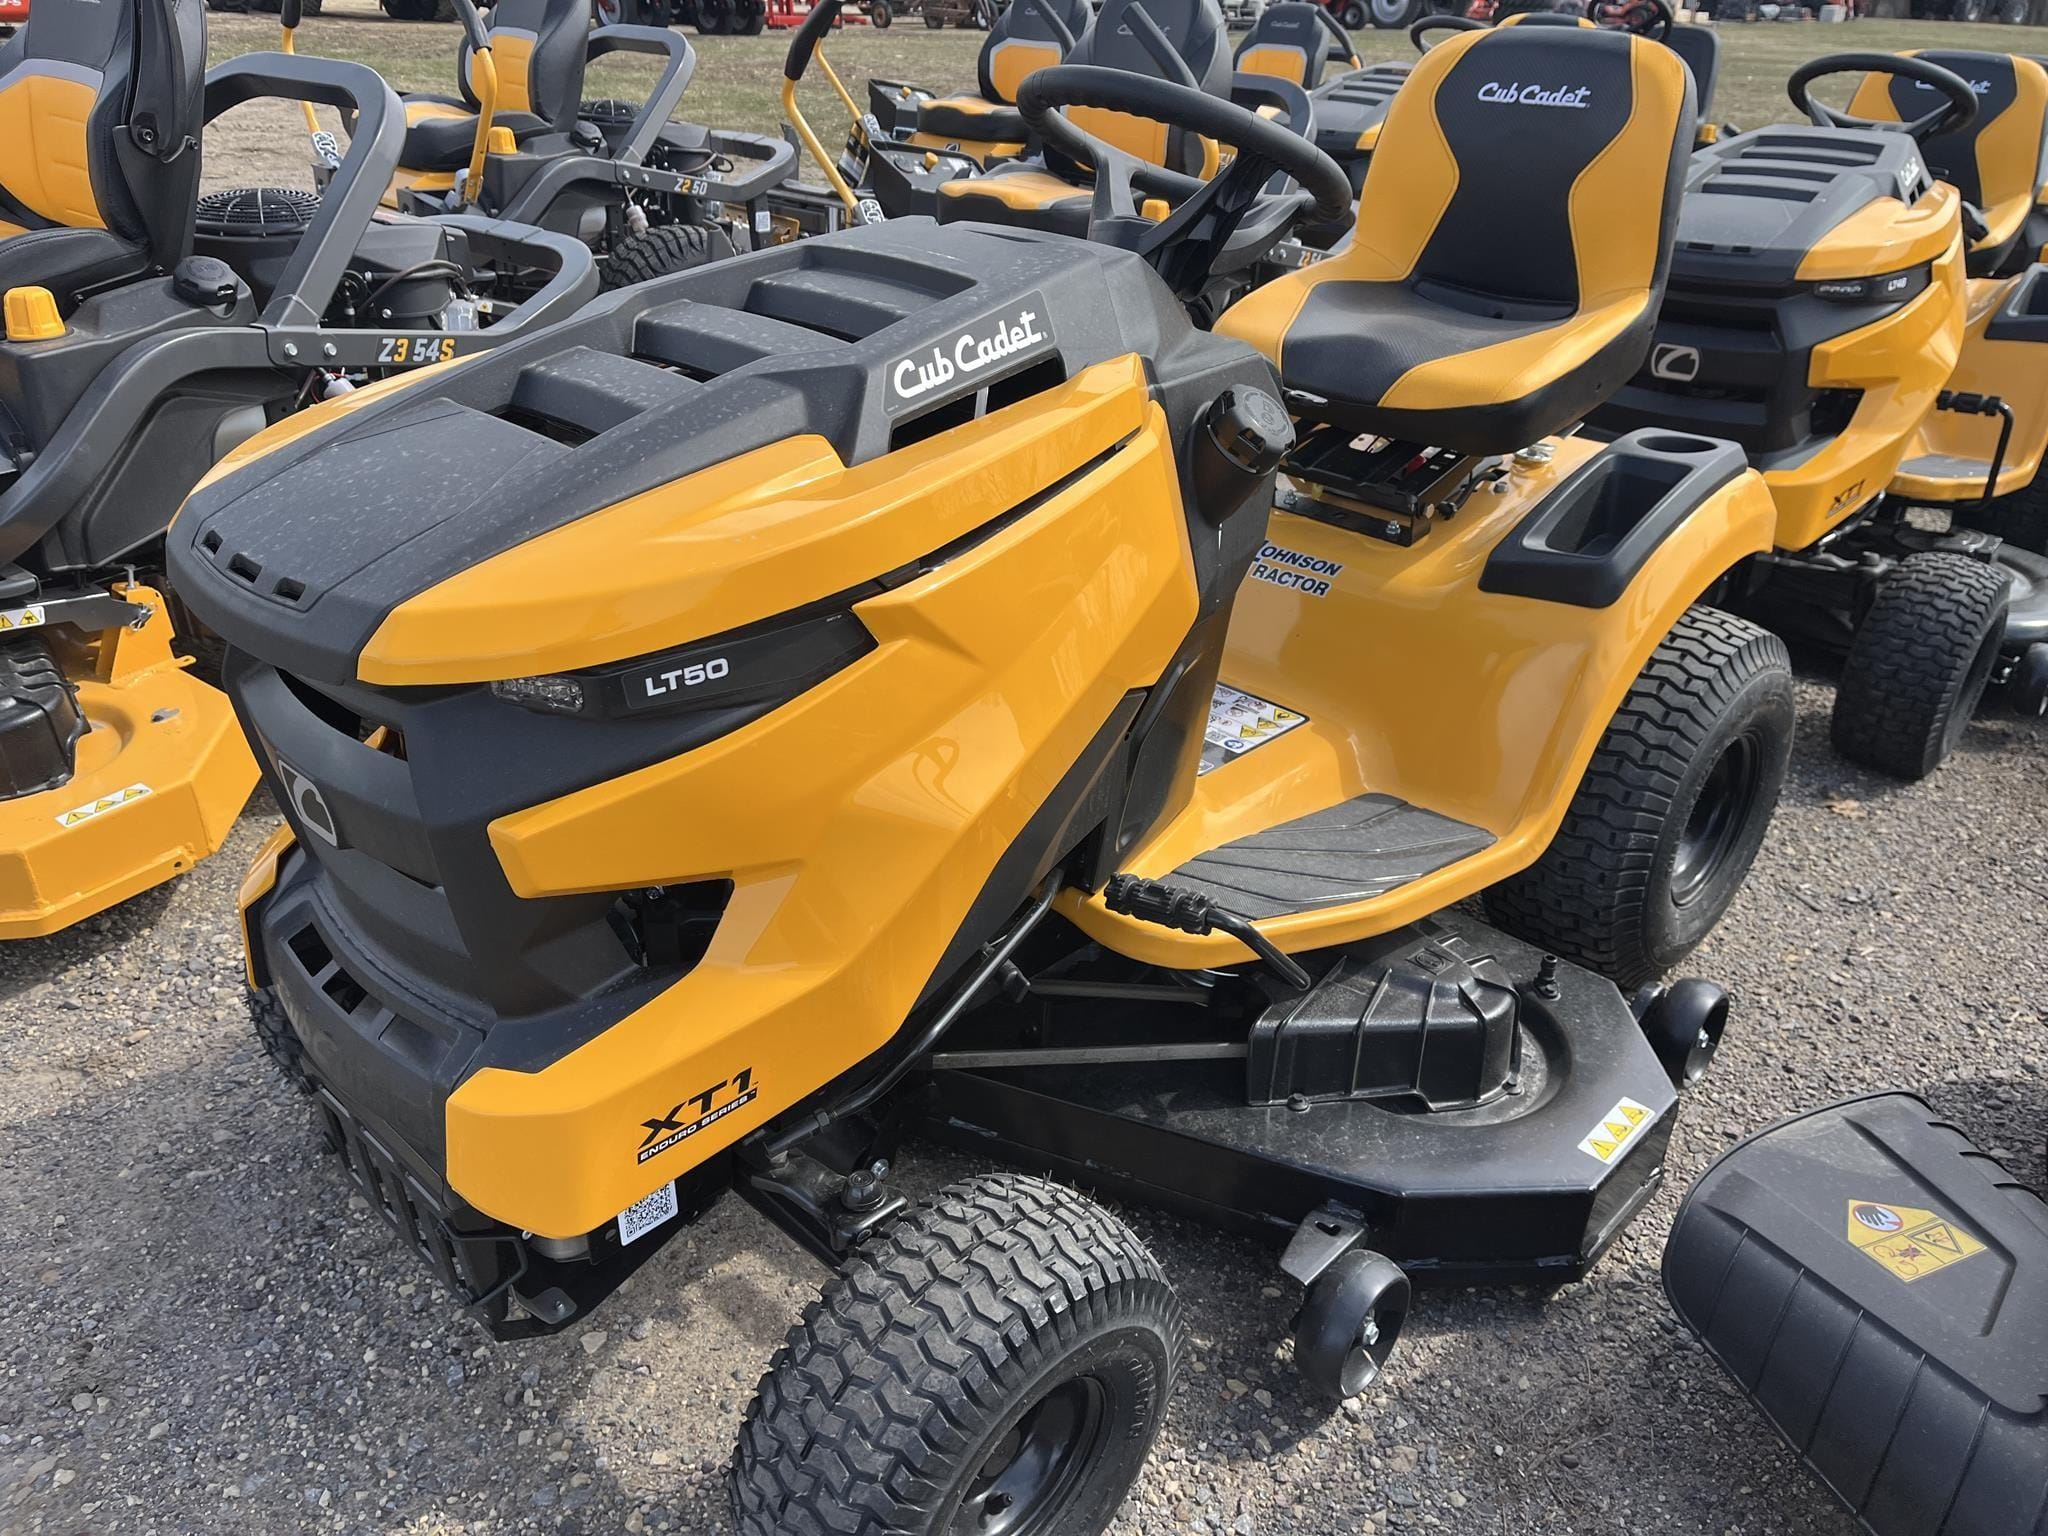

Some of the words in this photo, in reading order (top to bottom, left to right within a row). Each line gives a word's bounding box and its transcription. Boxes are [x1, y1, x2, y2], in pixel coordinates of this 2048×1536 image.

[1478, 82, 1519, 103] Cub
[1519, 85, 1591, 108] Cadet
[674, 178, 691, 192] Z2
[692, 180, 708, 195] 50
[378, 338, 409, 362] Z3
[413, 338, 455, 362] 54S
[893, 347, 955, 399] Cub
[954, 310, 1042, 372] Cadet
[645, 658, 729, 697] LT50
[638, 1066, 752, 1150] XT1
[640, 1124, 697, 1161] ENDURO
[701, 1094, 749, 1126] SERIES
